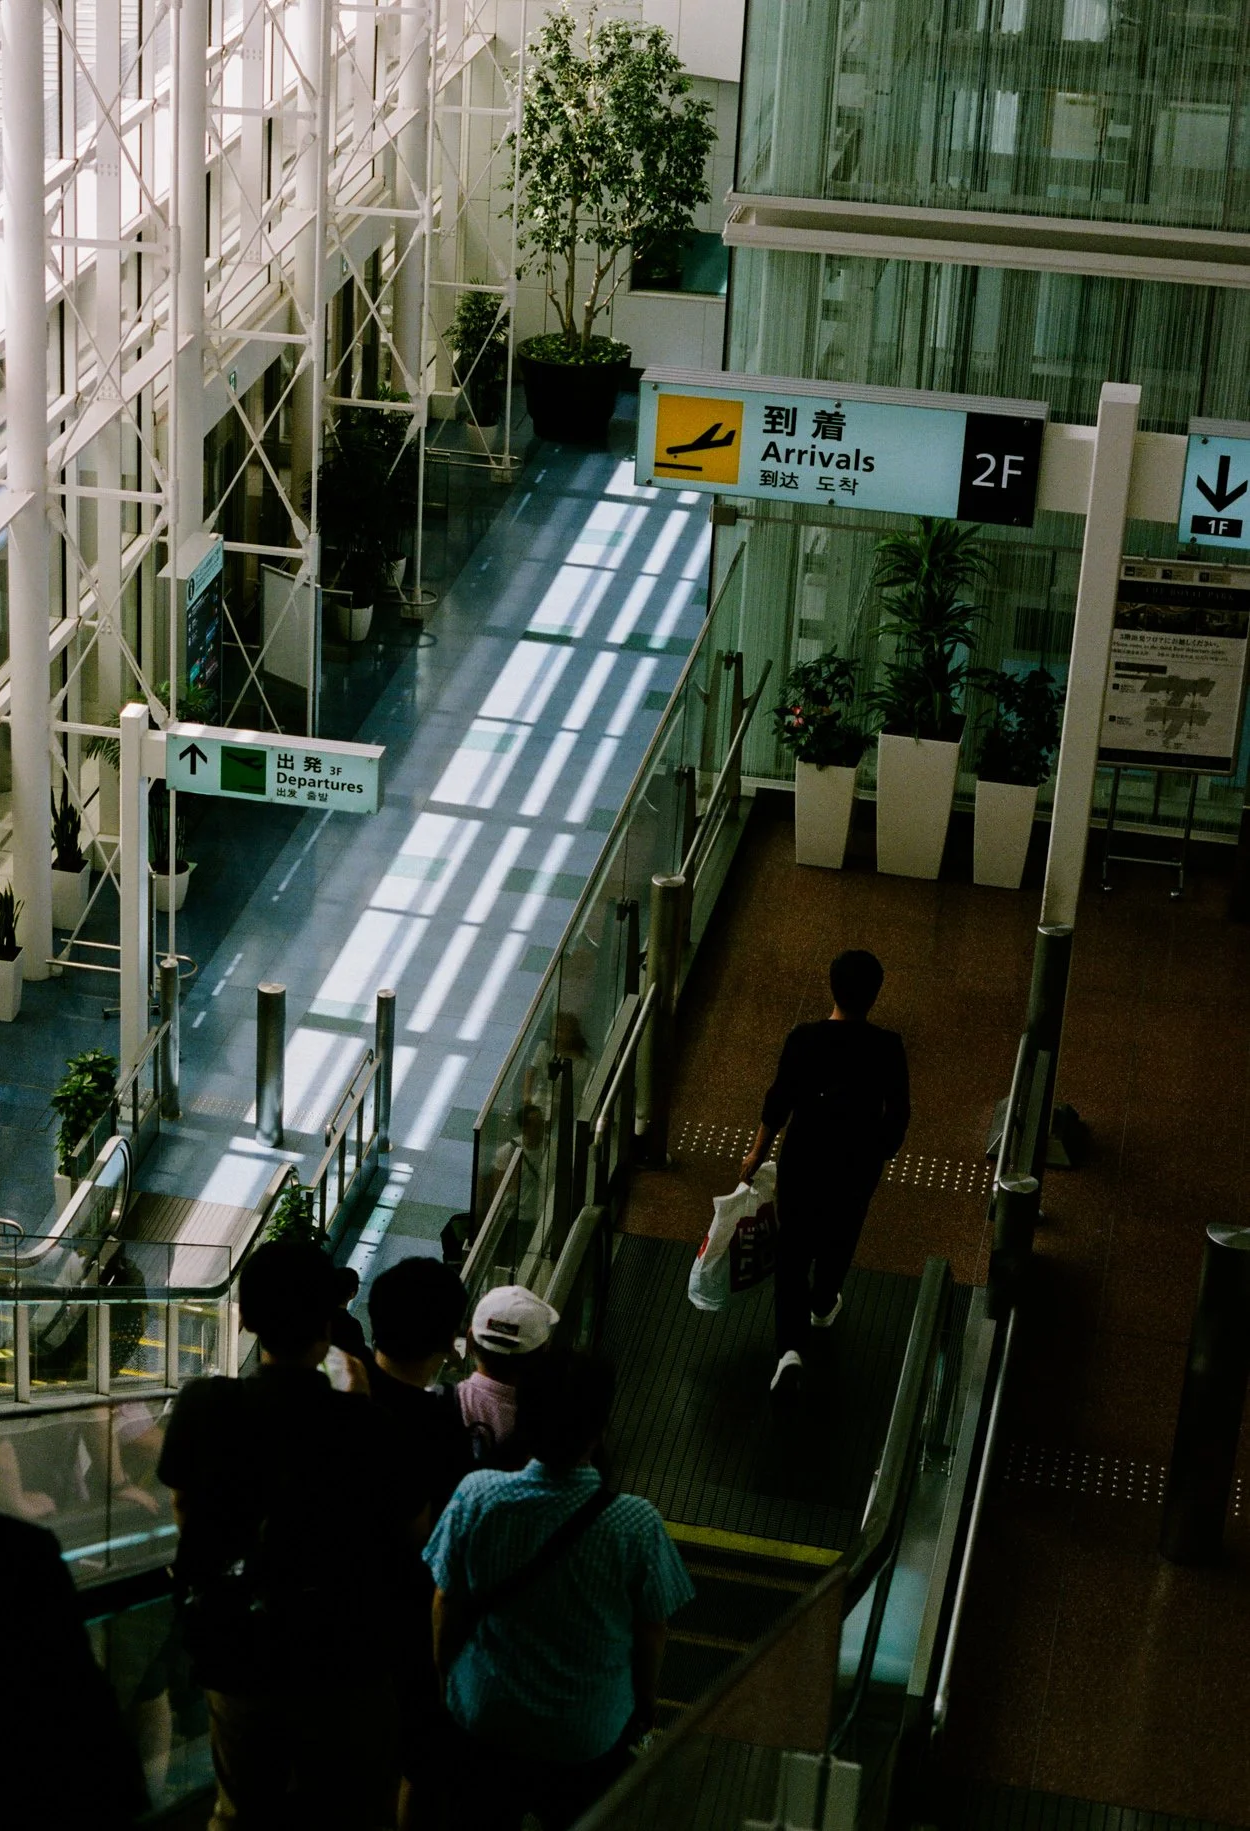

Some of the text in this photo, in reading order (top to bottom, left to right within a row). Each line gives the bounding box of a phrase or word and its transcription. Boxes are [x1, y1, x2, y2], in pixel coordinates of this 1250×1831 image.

[762, 405, 846, 441] 到着
[760, 441, 875, 472] Arrivals
[759, 469, 799, 489] 到达
[972, 453, 1025, 489] 2F
[816, 476, 859, 496] 도착
[1207, 519, 1229, 535] 1F
[330, 766, 342, 776] 3F
[276, 772, 364, 793] Departures
[277, 787, 297, 798] 出发
[307, 791, 328, 802] 출발
